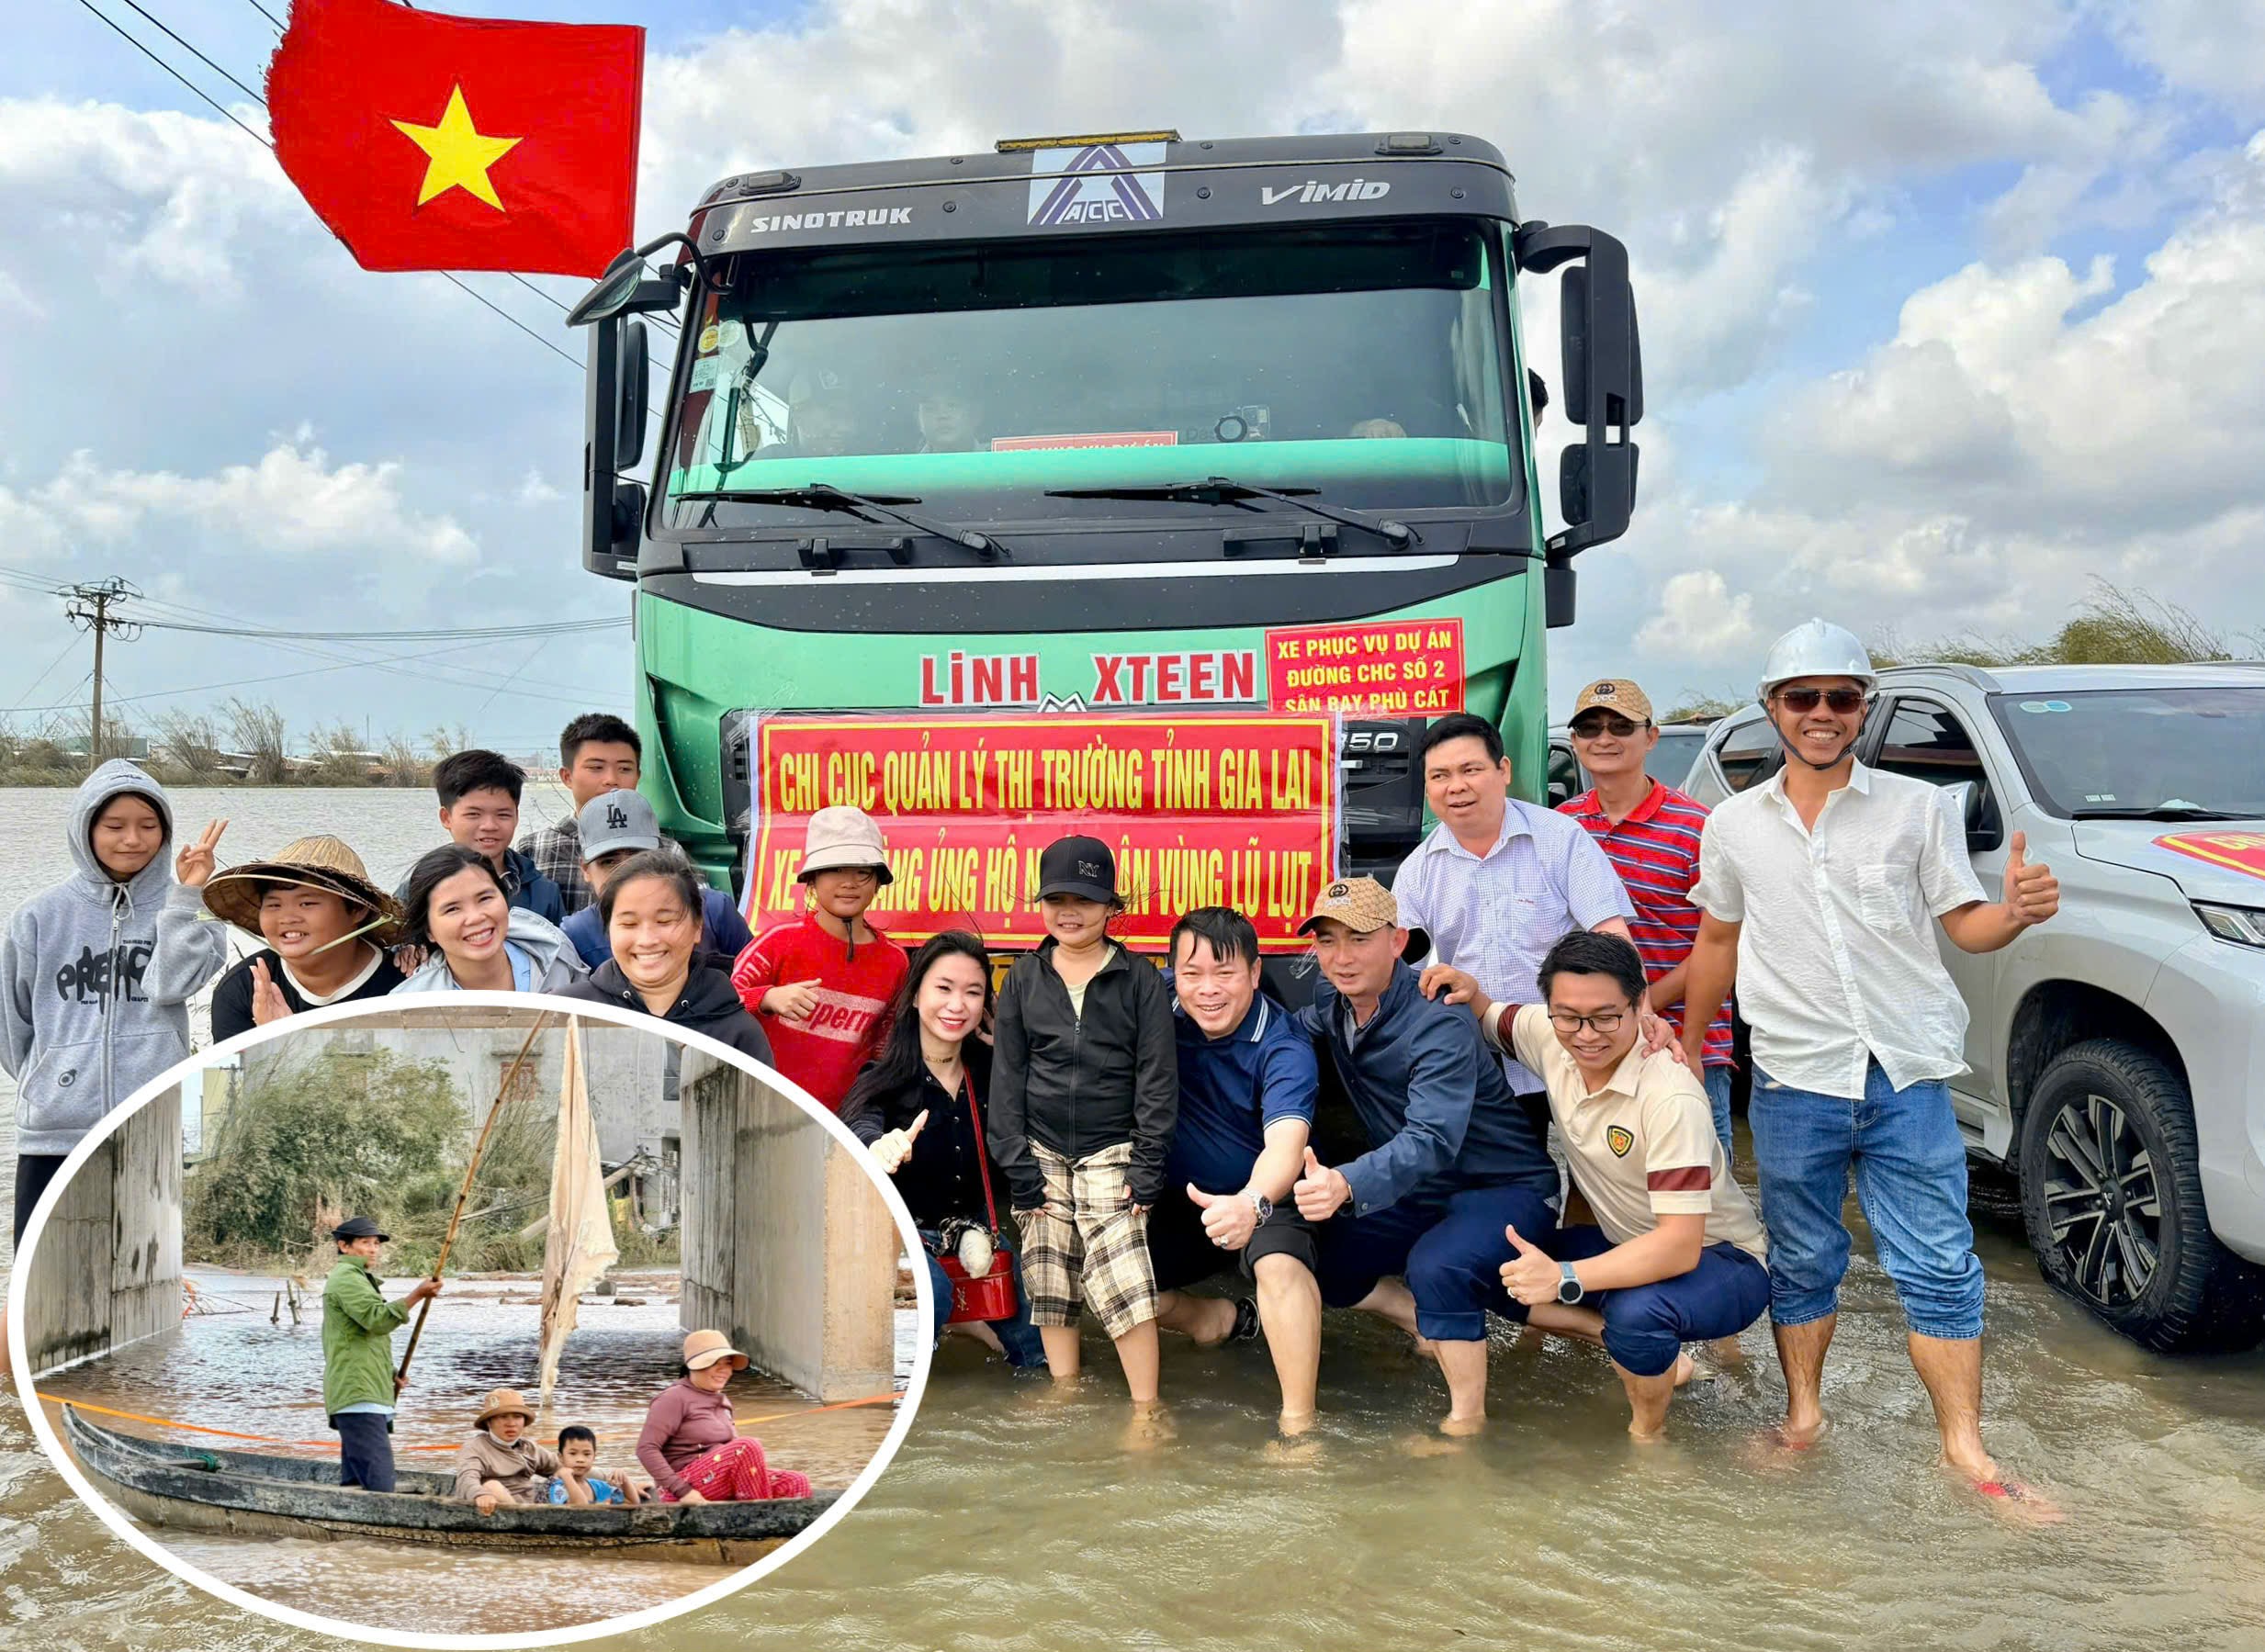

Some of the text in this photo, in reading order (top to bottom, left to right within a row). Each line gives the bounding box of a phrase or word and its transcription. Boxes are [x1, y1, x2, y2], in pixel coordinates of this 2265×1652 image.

[750, 207, 913, 232] SINOTRUK
[1064, 200, 1126, 221] ACC
[1278, 626, 1452, 660] XE PHỤC VỤ DỰ ÁN
[1094, 653, 1254, 702] XTEEN
[1287, 655, 1445, 688] ĐƯỜNG CHC SỐ 2
[1285, 685, 1449, 713] SÂN BAY PHÙ CÁT
[781, 752, 820, 811] CHI
[884, 731, 951, 816] QUẢN
[959, 737, 987, 809] LÝ
[995, 749, 1033, 822] THỊ
[1041, 734, 1143, 809] TRƯỜNG
[1151, 728, 1210, 809] TỈNH
[1219, 748, 1263, 810] GIA
[1271, 749, 1311, 810] LAI
[607, 804, 627, 829] LA
[2204, 835, 2265, 850] CH
[767, 849, 802, 911] XE
[866, 835, 923, 912] ÀNG
[929, 826, 979, 912] ỦNG
[985, 833, 1018, 928] HỘ
[1110, 834, 1150, 916] ÂN
[1158, 835, 1223, 916] VÙNG
[1231, 837, 1260, 917] LŨ
[1268, 850, 1313, 933] LỤT
[1078, 860, 1099, 878] NY
